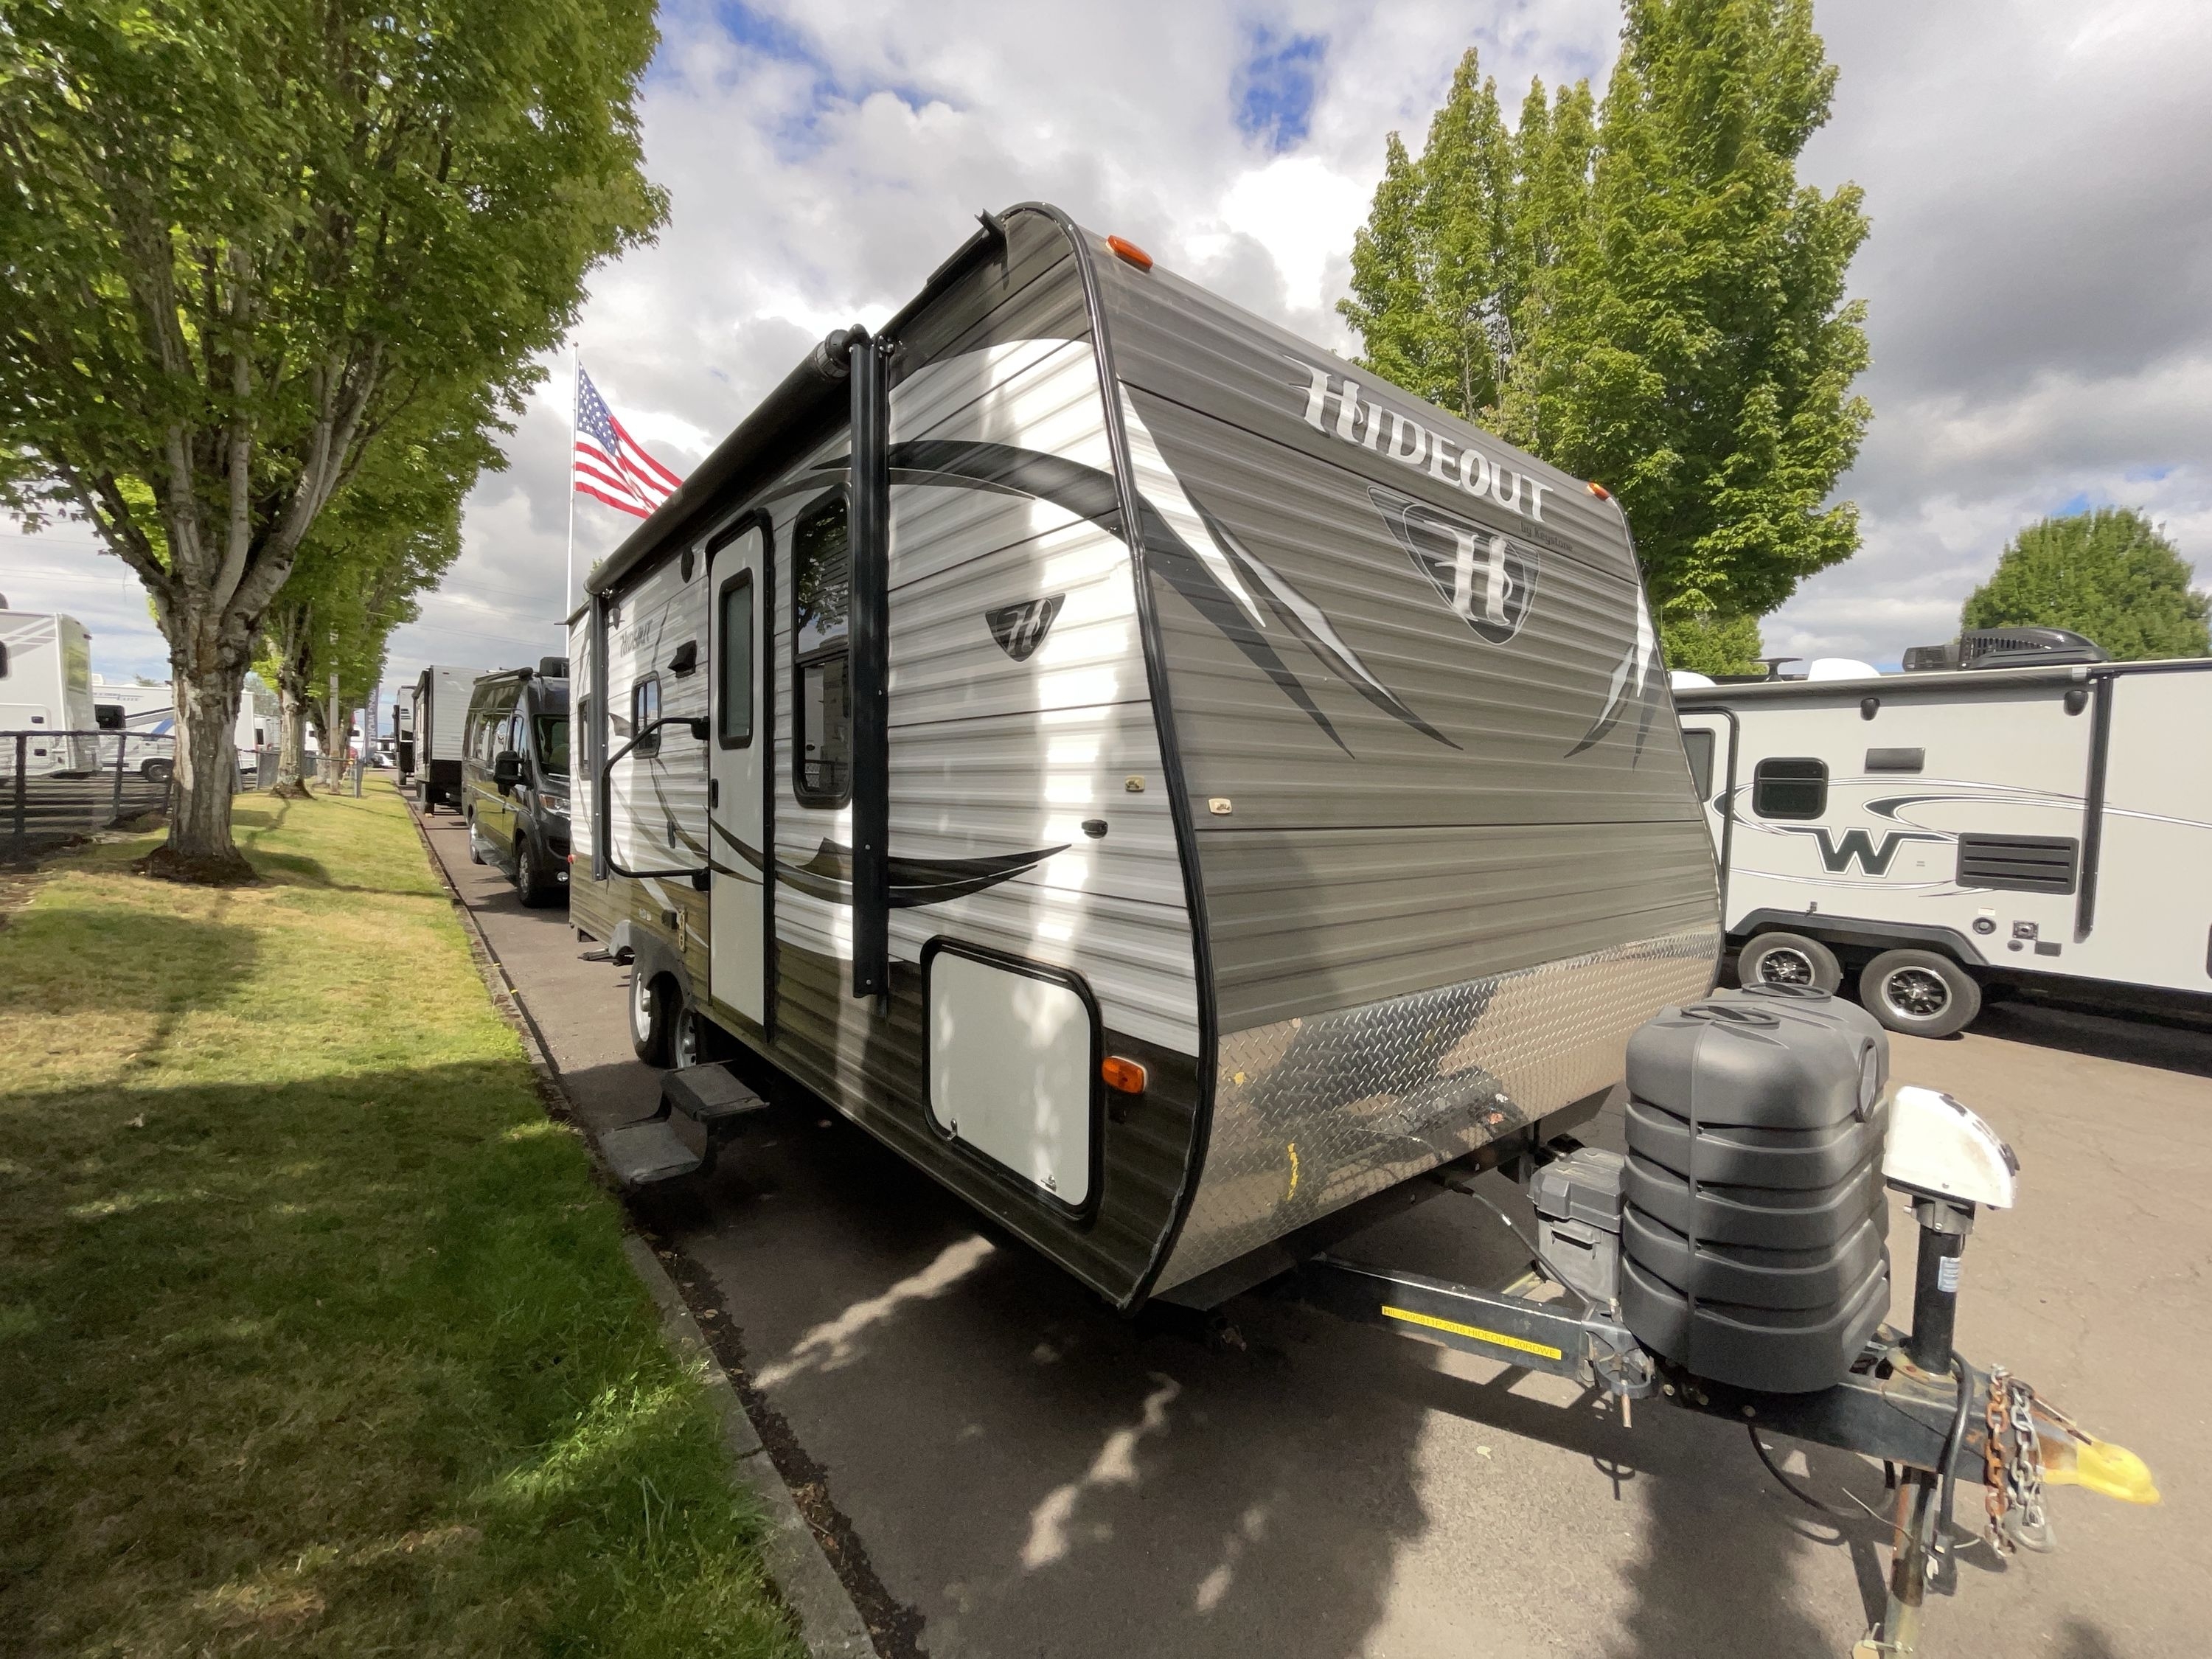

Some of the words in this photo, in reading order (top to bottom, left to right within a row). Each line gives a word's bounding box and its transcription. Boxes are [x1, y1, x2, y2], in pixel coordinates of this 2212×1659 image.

[1283, 355, 1554, 523] HIDEOUT
[1520, 520, 1531, 538] by
[1534, 525, 1574, 552] Keystone
[1444, 1322, 1466, 1334] 2016
[1468, 1328, 1512, 1344] HIDEOUT
